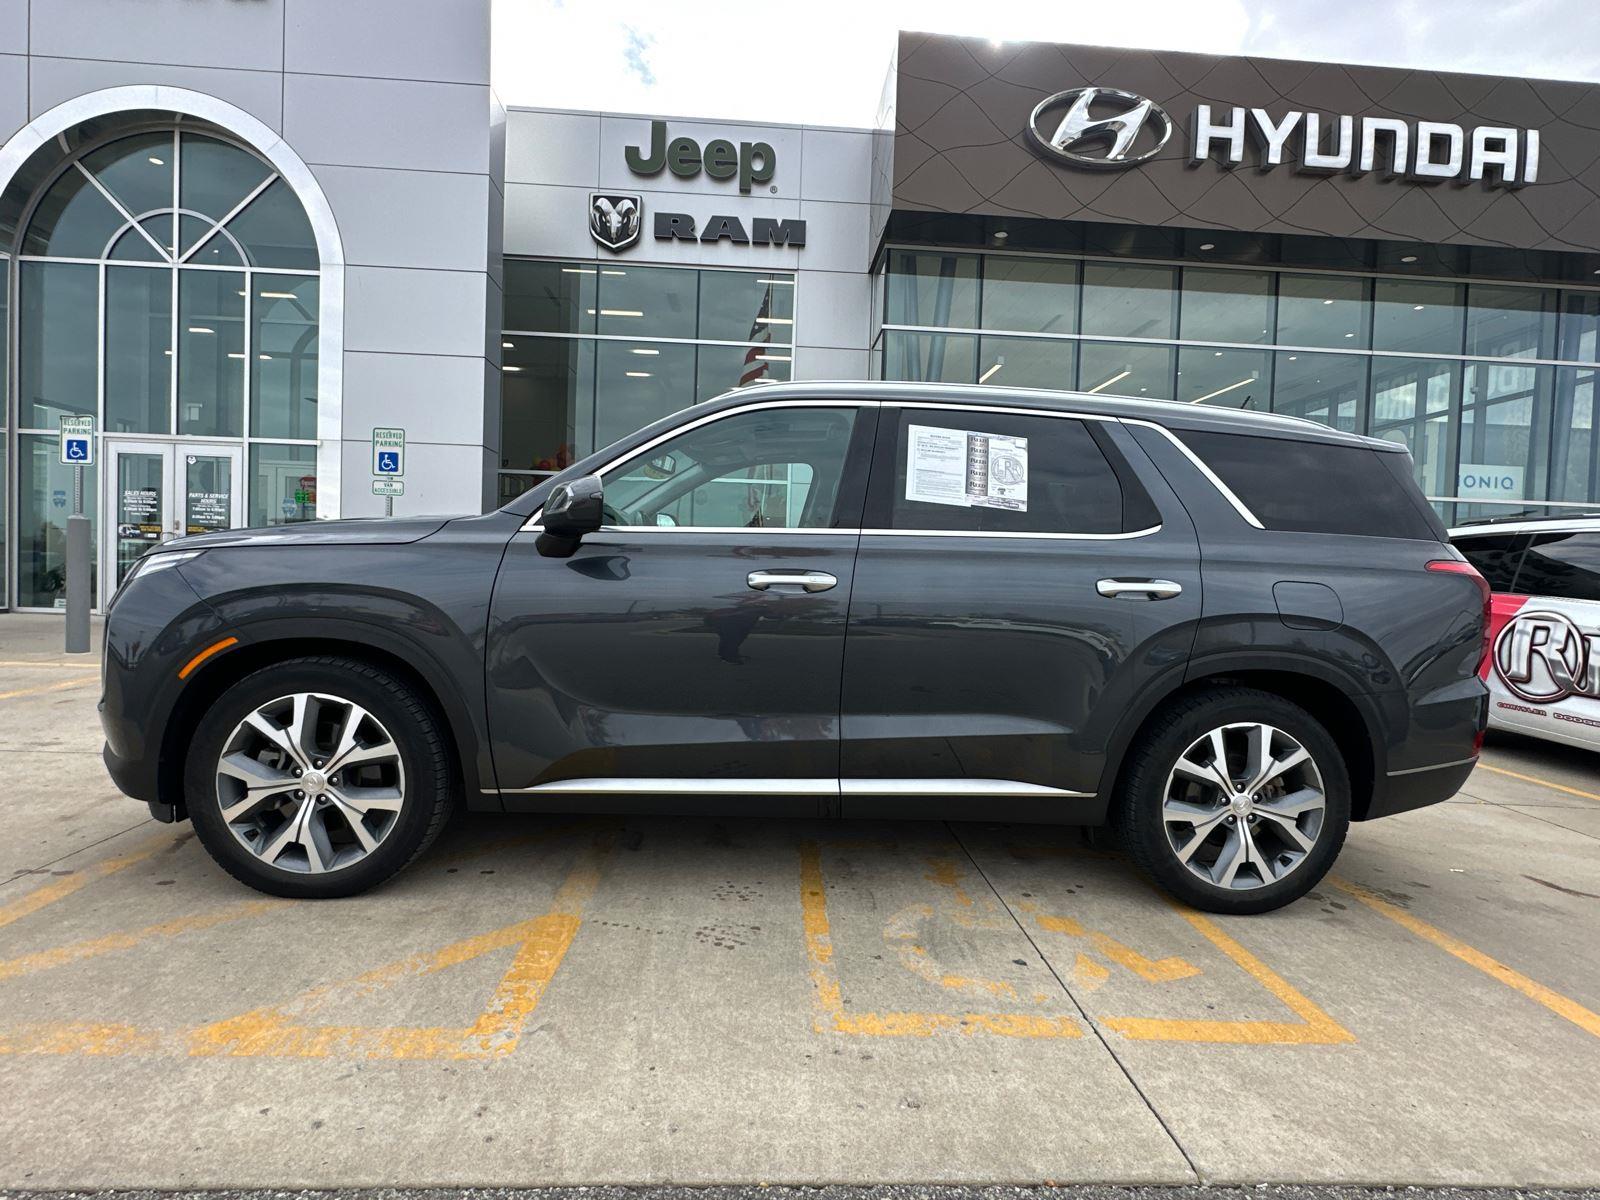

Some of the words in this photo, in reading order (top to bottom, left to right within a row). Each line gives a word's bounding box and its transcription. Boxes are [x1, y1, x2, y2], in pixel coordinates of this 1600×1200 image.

[1194, 104, 1541, 186] HYUNDAI
[624, 120, 777, 193] Jeep
[654, 212, 807, 247] RAM
[63, 417, 91, 426] RESERVED
[63, 427, 92, 435] PARKING
[375, 432, 403, 440] RESERVED
[375, 440, 403, 448] PARKING
[1496, 701, 1547, 717] CHRYSLER
